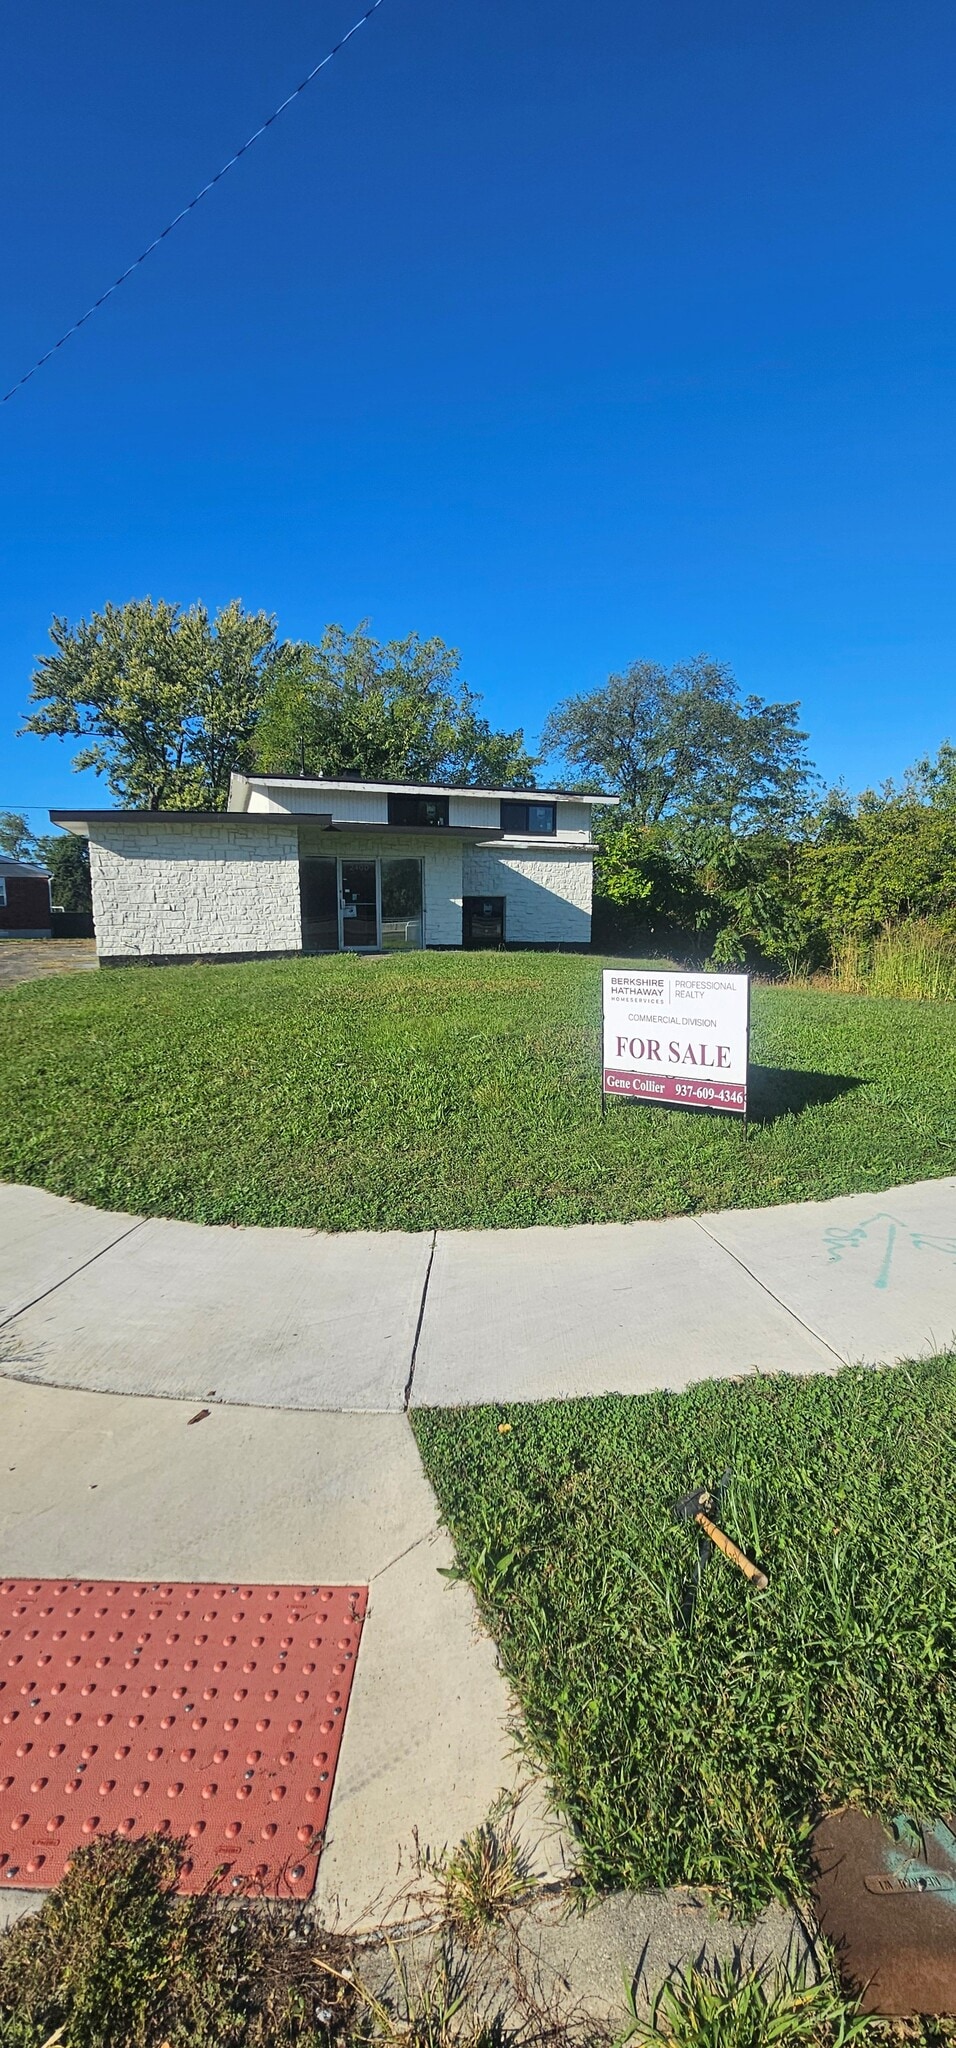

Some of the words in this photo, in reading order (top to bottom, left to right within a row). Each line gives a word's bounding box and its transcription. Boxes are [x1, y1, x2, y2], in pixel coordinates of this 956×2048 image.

[611, 977, 664, 987] BERKSHIRE
[675, 980, 737, 991] PROFESSIONAL
[611, 987, 664, 997] HATHAWAY
[675, 990, 704, 999] REALTY
[611, 997, 664, 1005] HOMESERVICES
[628, 1014, 681, 1025] COMMERCIAL
[682, 1017, 717, 1028] DIVISION
[616, 1036, 662, 1061] FOR
[668, 1041, 731, 1068] SALE
[606, 1075, 631, 1089] Gene
[633, 1078, 665, 1094] Collier
[675, 1084, 743, 1104] 937-609-4346
